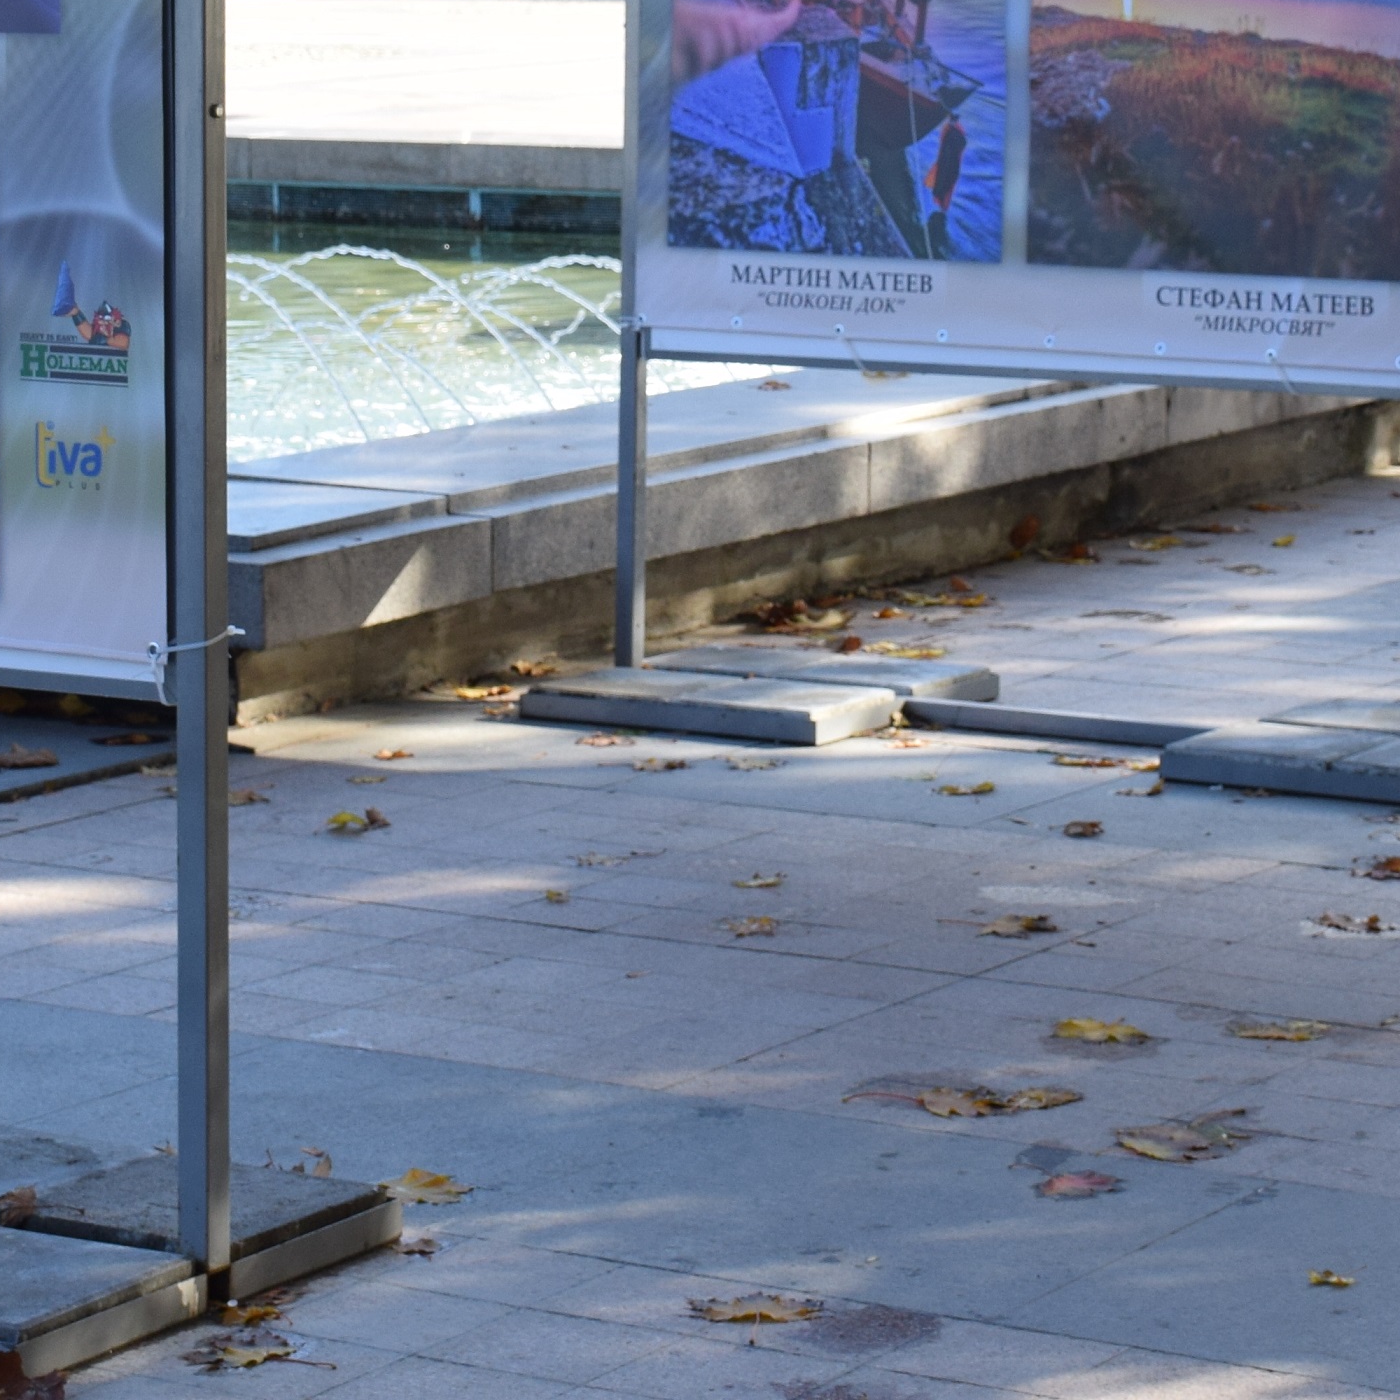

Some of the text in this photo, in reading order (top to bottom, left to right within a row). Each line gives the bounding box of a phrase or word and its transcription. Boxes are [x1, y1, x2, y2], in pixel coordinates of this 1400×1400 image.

[731, 264, 933, 294] МАРТИН МАТЕЕВ
[1156, 285, 1375, 316] СТЕФАН МАТЕЕВ
[20, 343, 128, 378] HOLLEMAN
